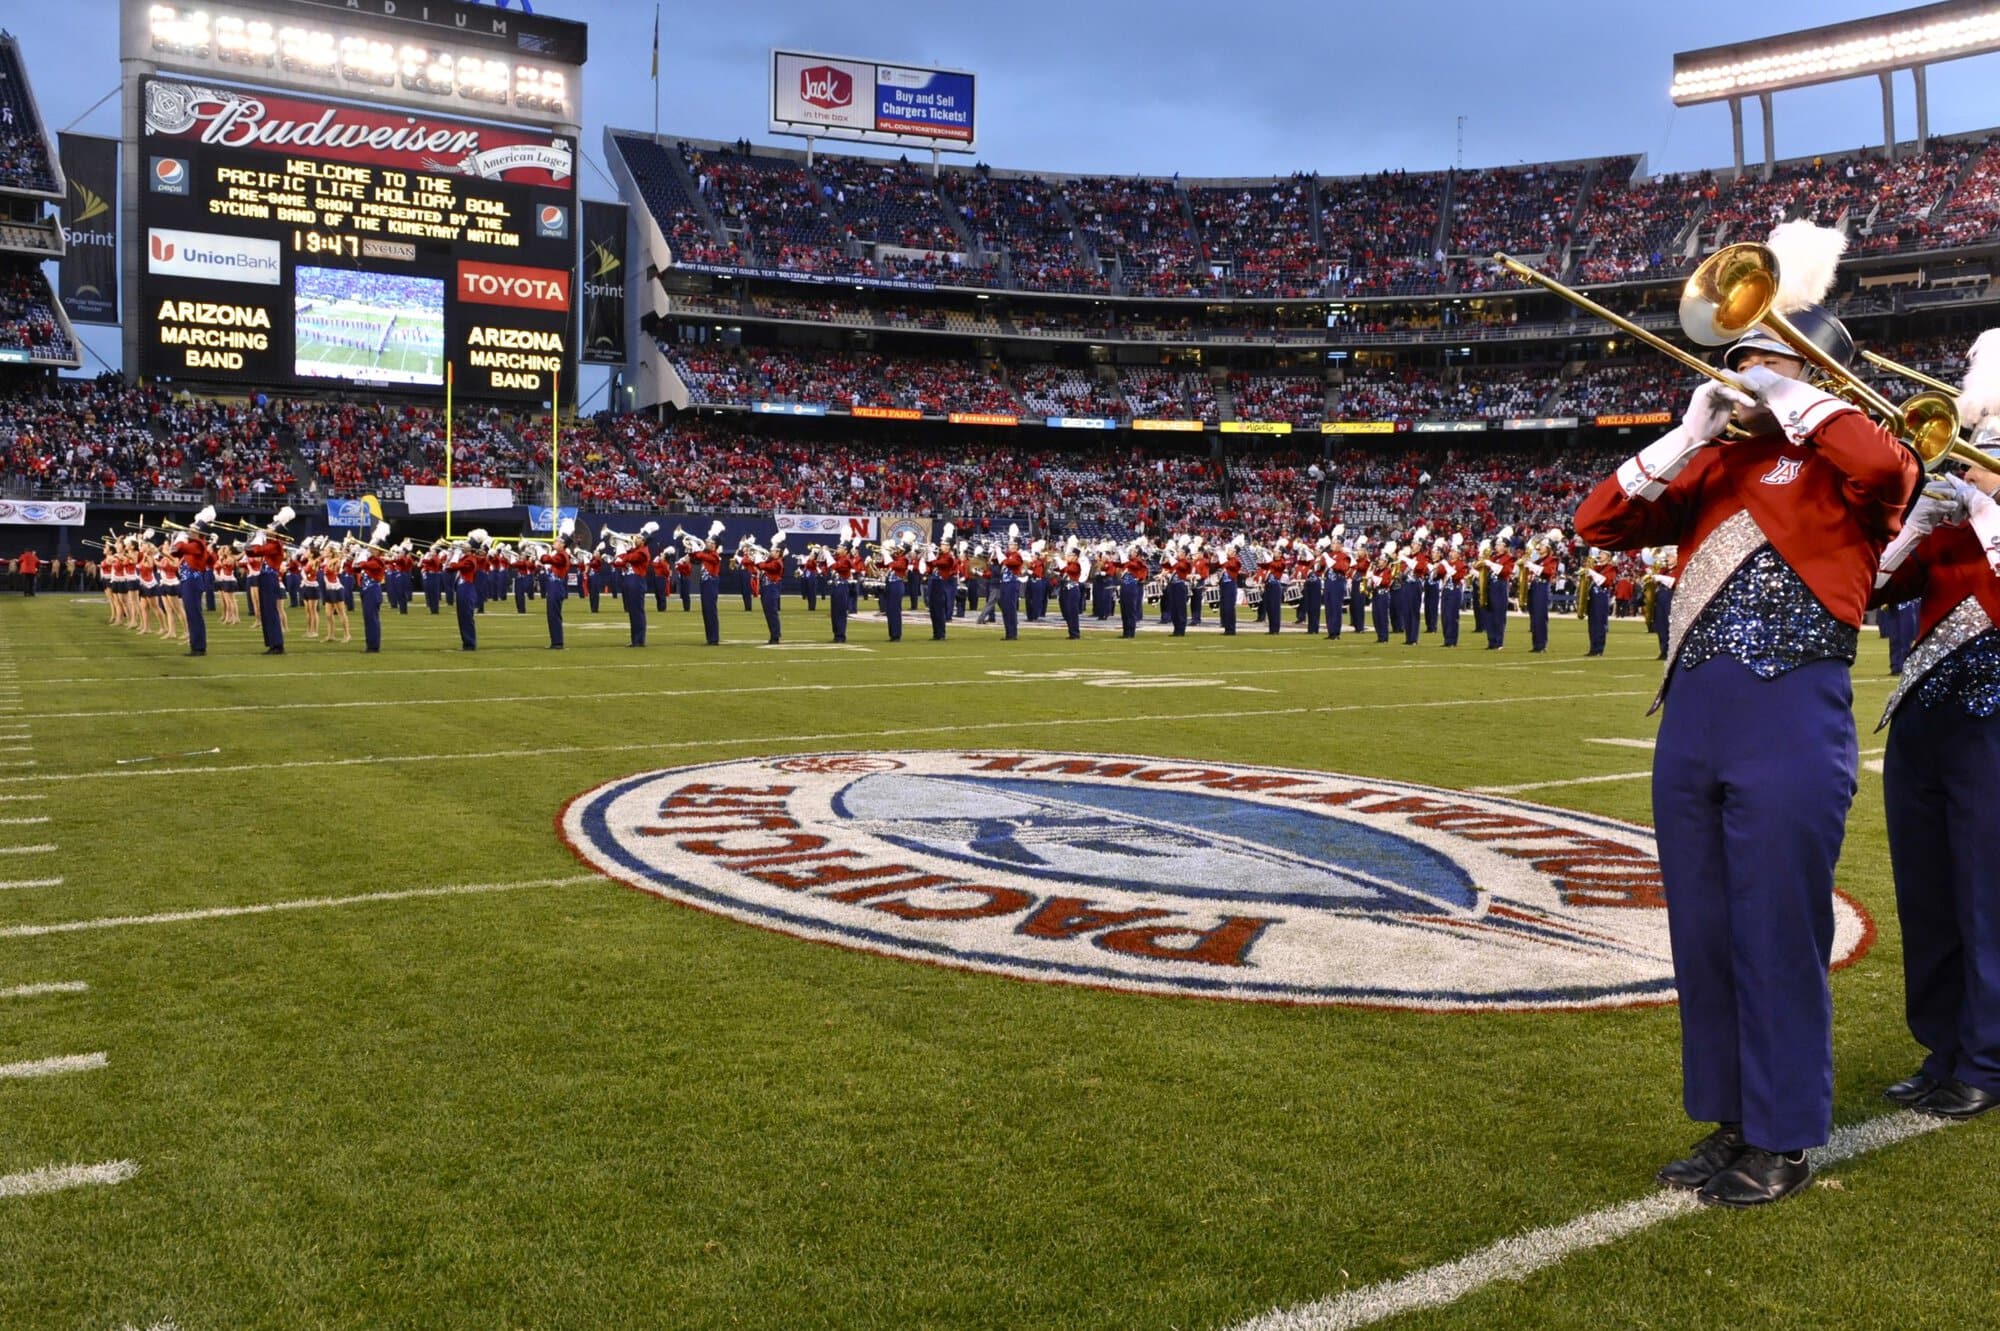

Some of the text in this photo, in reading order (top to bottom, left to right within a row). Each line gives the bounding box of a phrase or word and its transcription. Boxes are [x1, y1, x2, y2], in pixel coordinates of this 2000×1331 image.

[801, 71, 850, 104] Jack
[896, 90, 954, 107] Buy and Sell
[804, 110, 848, 122] in the box
[883, 102, 966, 122] Chargers Tickets!
[186, 99, 478, 153] Budweiser
[483, 152, 568, 169] American Lager
[286, 159, 451, 194] WELCOME TO THE
[158, 183, 182, 193] pepsi
[217, 167, 511, 217] PACIFIC LIFE HOLIDAY BOWL
[229, 187, 503, 231] PRE-GAME SHOW PRESENTED BY THE
[209, 200, 520, 247] SYCUAN BAND OF THE KUMEYAAY NATION
[63, 227, 114, 247] Sprint
[295, 230, 359, 257] 19:47
[364, 243, 415, 256] SYCUAN
[697, 264, 709, 272] FAN
[711, 265, 738, 274] CONDUCT
[761, 269, 776, 277] TEXT
[851, 277, 880, 286] LOCATION
[463, 273, 564, 301] TOYOTA
[584, 282, 624, 298] Sprint
[158, 300, 271, 328] ARIZONA
[161, 326, 268, 350] MARCHING
[467, 326, 564, 352] ARIZONA
[186, 350, 243, 369] BAND
[470, 350, 561, 372] MARCHING
[491, 371, 540, 390] BAND
[853, 406, 921, 419] WELLS FARGO
[1598, 414, 1671, 426] WELLS FARGO
[1760, 456, 1803, 485] A
[848, 518, 870, 539] N
[961, 755, 1318, 793] BOWL
[635, 783, 1285, 969] PACIFIC LIFE
